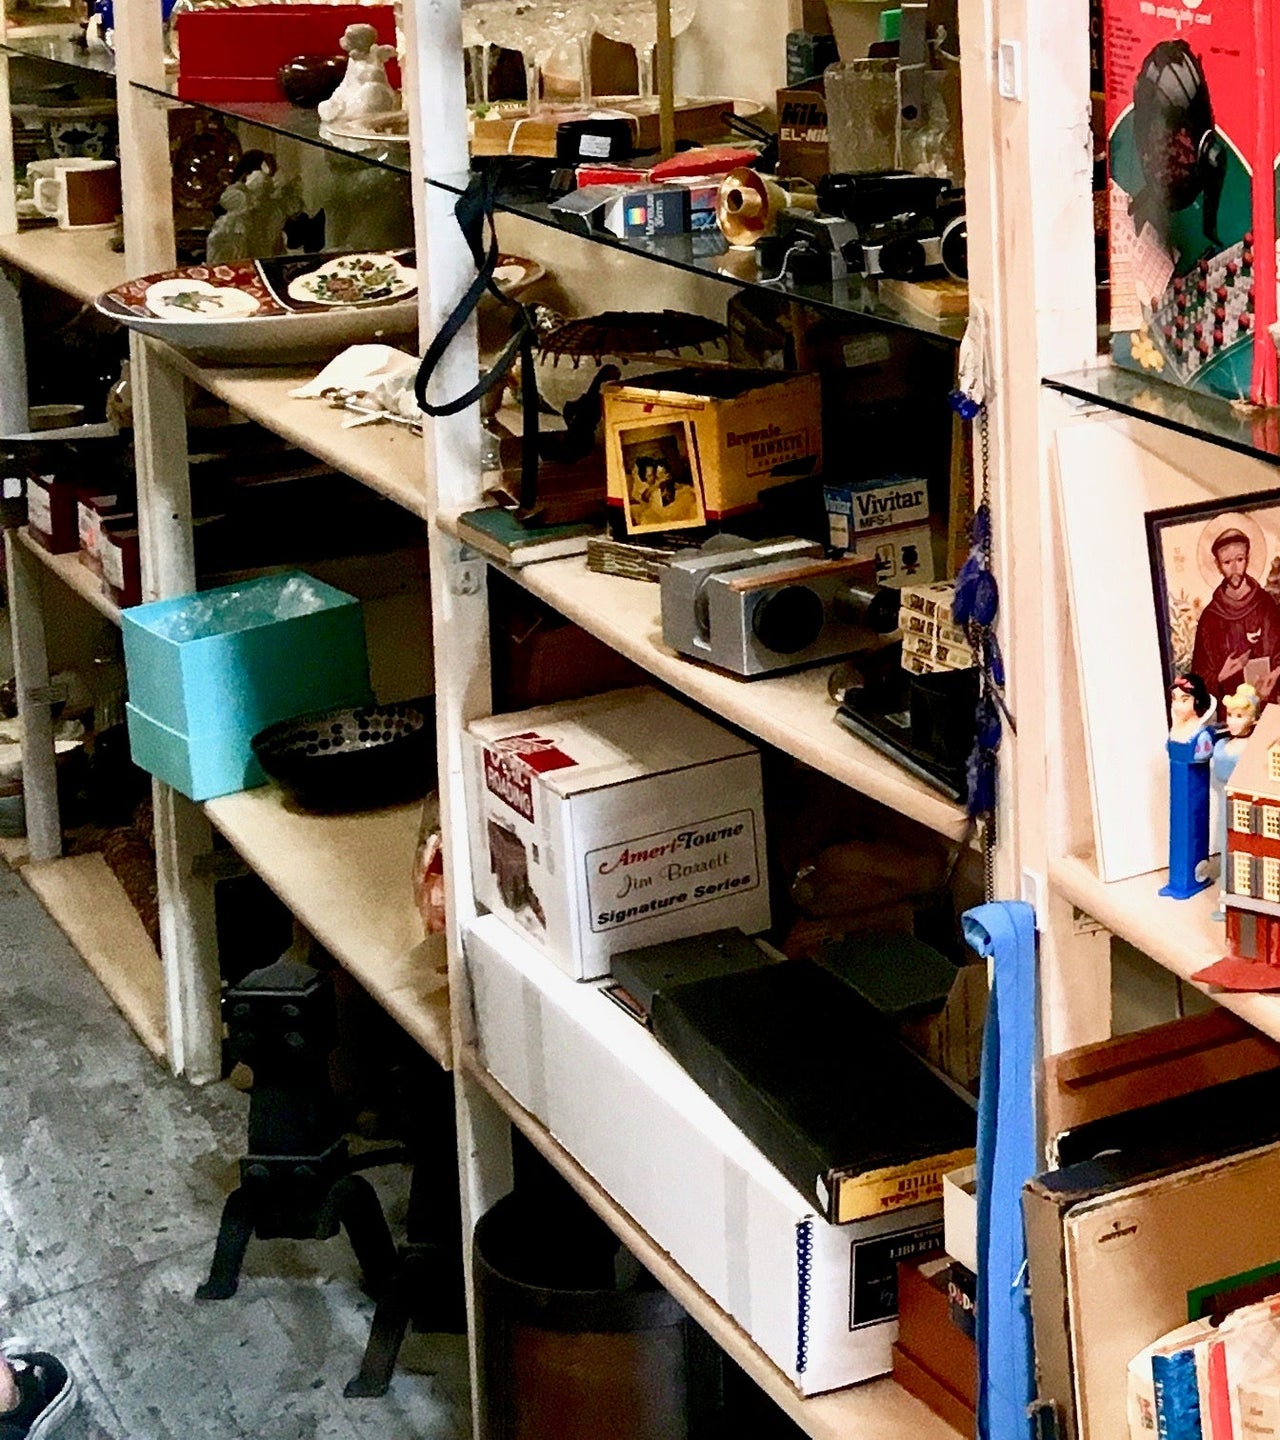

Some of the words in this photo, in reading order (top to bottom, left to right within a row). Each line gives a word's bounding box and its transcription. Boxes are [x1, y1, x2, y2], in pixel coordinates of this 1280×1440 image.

[856, 491, 924, 516] Vivitar
[860, 514, 894, 529] MFS-1
[599, 823, 745, 875] Ameri-Towne
[616, 874, 653, 899] Jim
[597, 892, 688, 925] Signature
[694, 874, 751, 899] Series
[897, 1173, 938, 1193] TITLER
